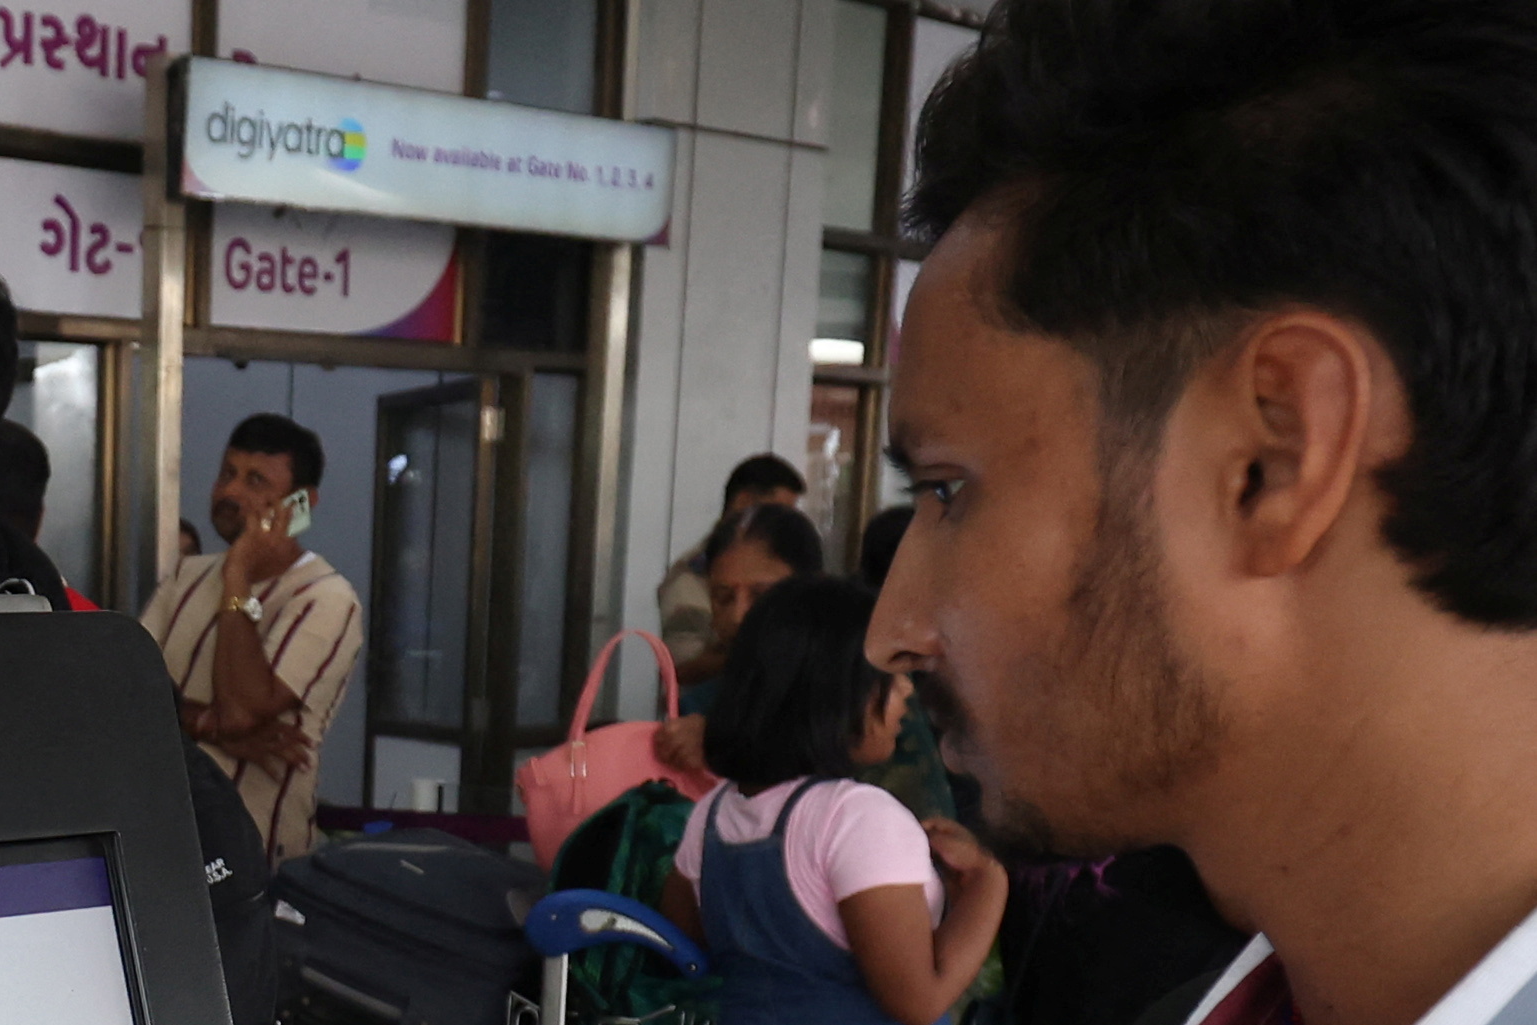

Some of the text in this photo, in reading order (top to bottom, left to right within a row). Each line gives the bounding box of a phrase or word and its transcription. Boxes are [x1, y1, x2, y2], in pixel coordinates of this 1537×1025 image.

[206, 101, 346, 161] digiyatra
[391, 137, 427, 161] Now
[433, 147, 501, 171] available
[508, 156, 522, 174] at
[528, 154, 561, 178] Gate
[39, 195, 144, 276] ગેટ-
[224, 237, 351, 297] Gate-1
